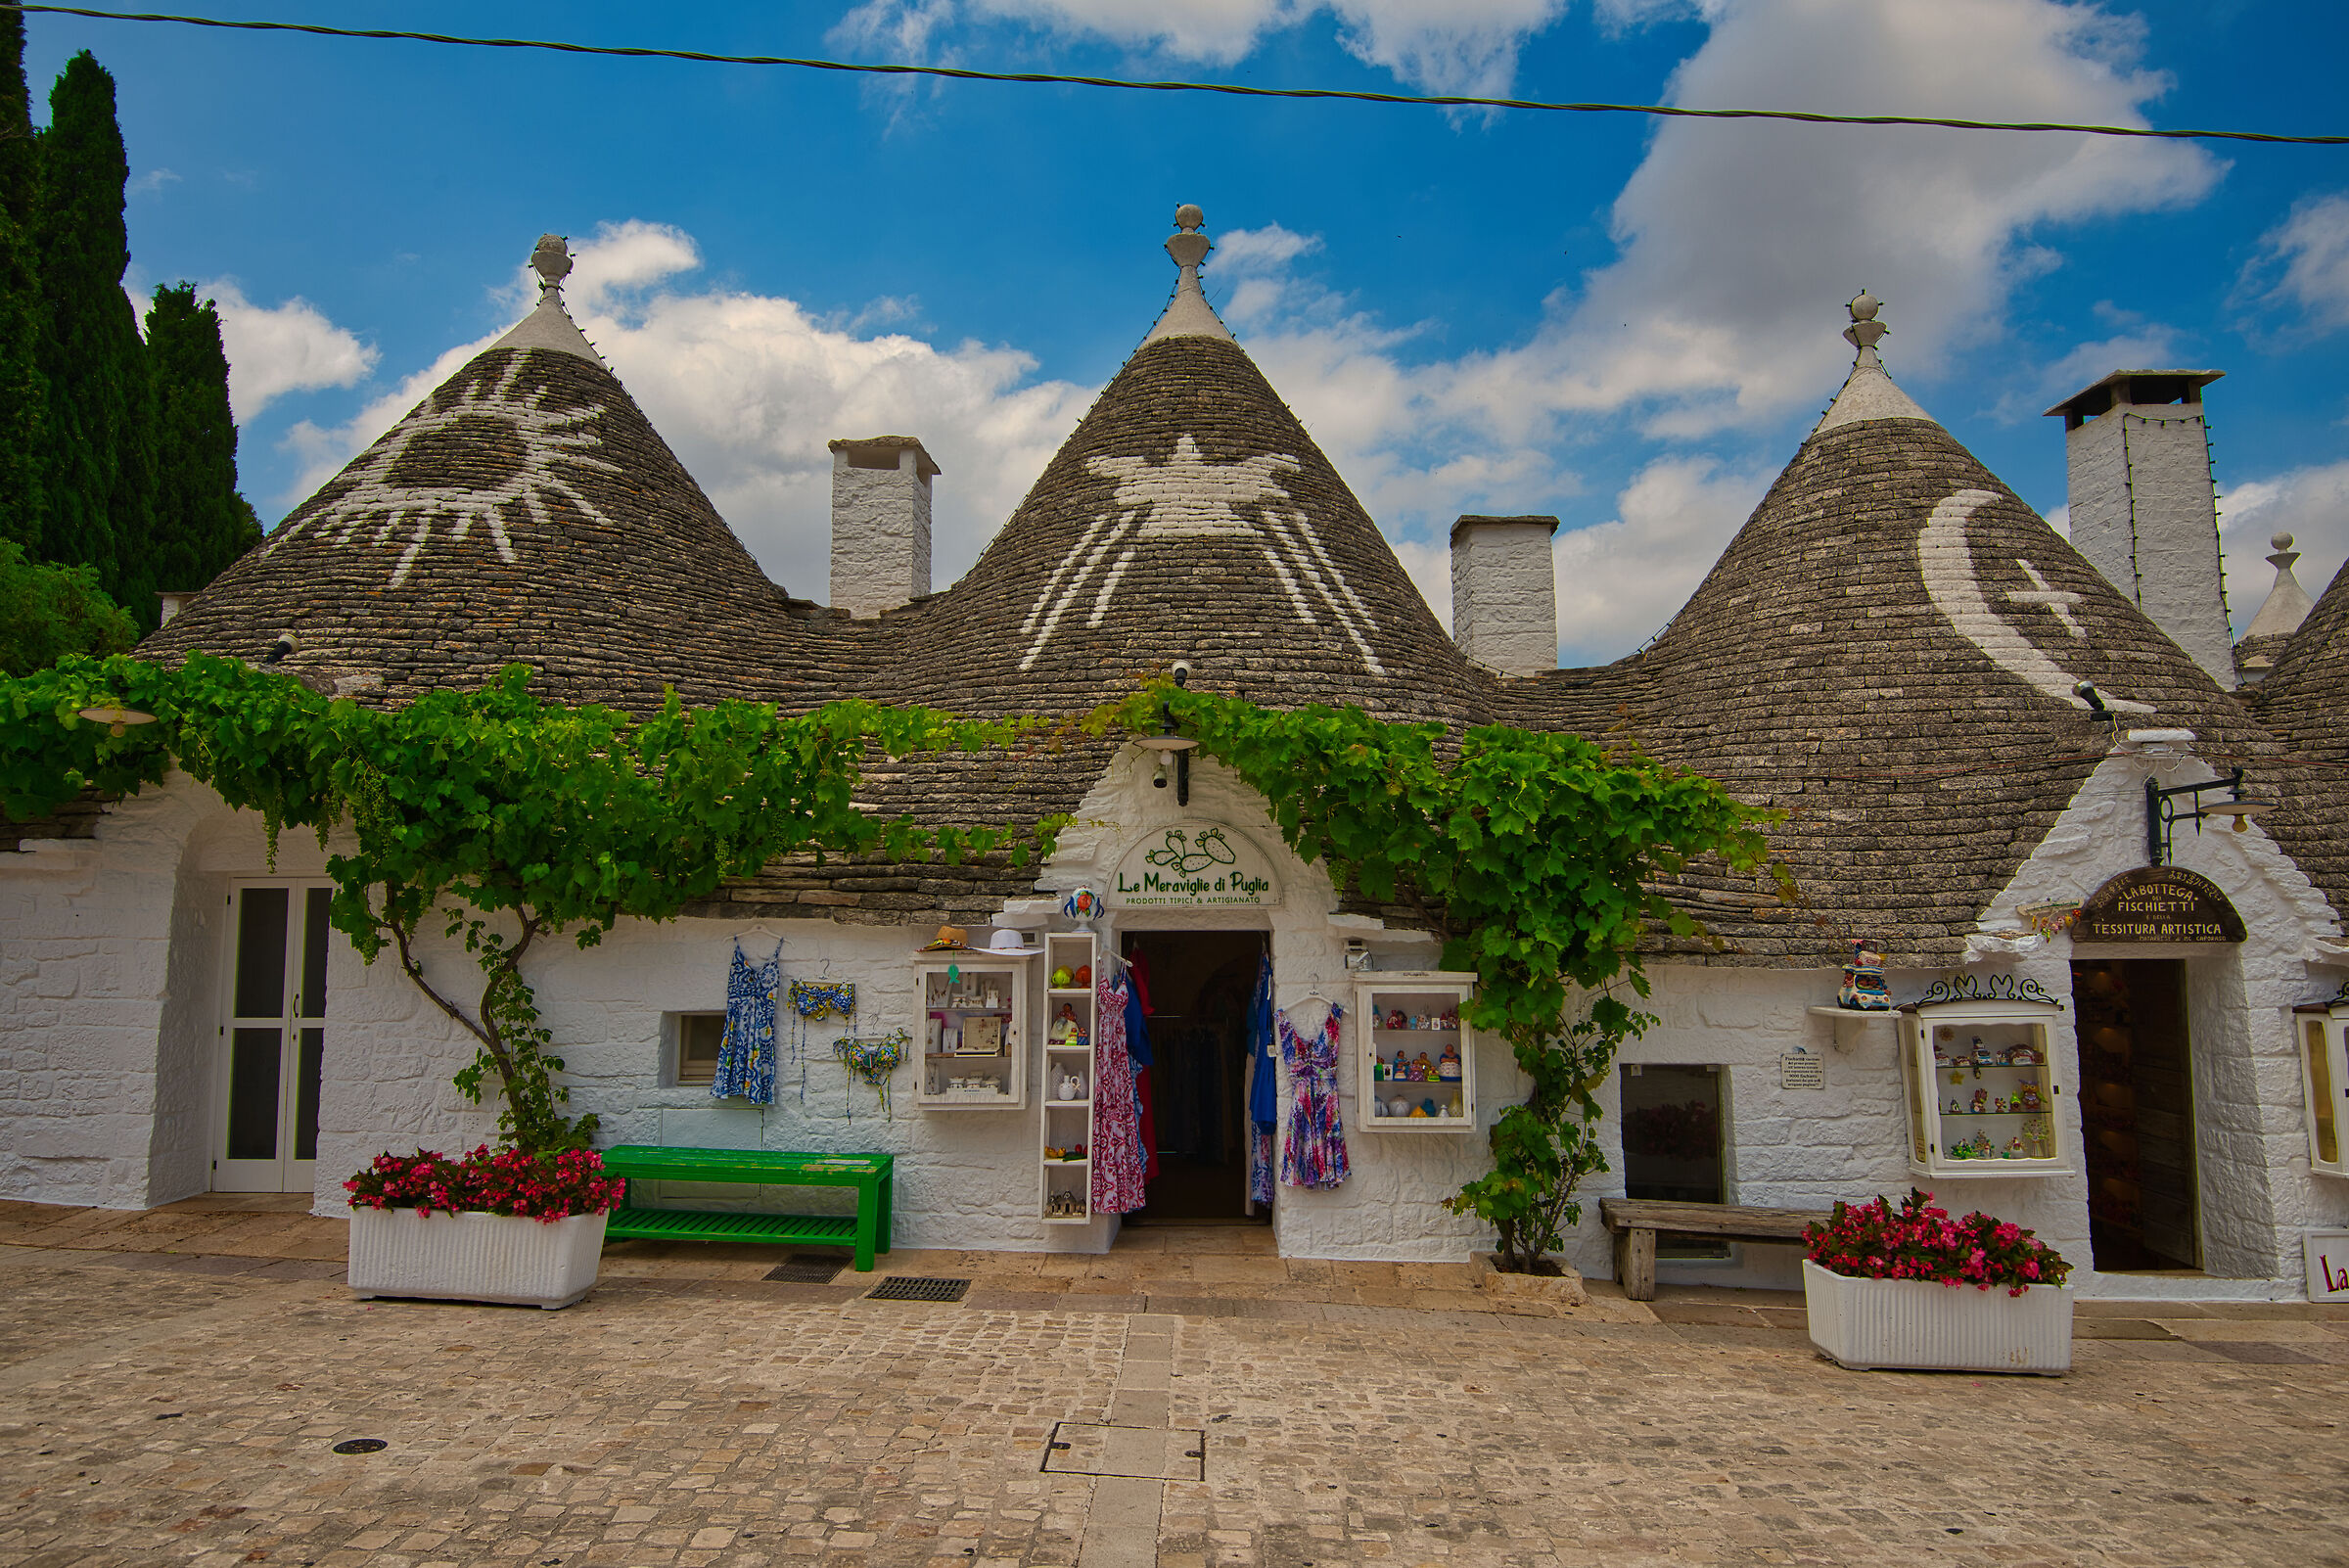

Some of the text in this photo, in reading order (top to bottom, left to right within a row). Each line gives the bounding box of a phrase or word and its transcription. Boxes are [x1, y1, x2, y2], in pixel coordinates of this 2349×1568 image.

[1118, 871, 1269, 897] Le Meraviglie di Puglia
[2118, 901, 2194, 912] FISCHIETTI
[2093, 923, 2222, 935] TESSITURA ARTISTICA
